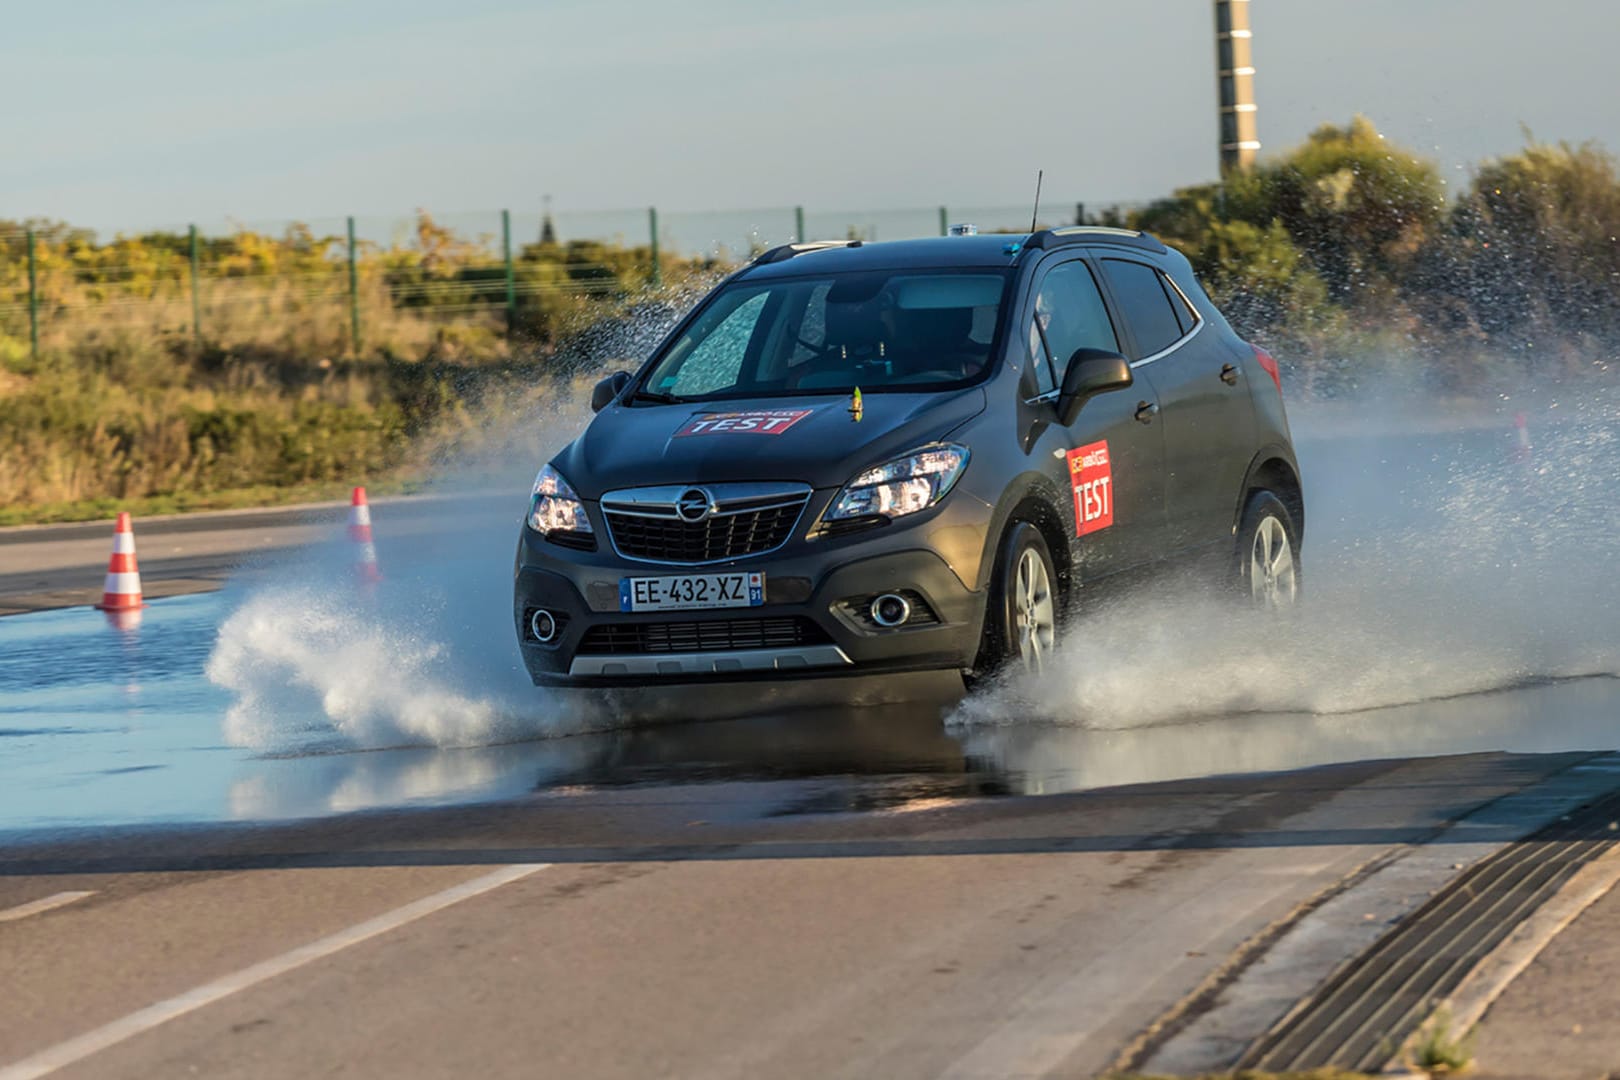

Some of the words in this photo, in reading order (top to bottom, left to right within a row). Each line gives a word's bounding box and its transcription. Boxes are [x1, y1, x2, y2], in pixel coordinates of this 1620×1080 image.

[690, 417, 791, 433] TEST
[1074, 476, 1110, 524] TEST
[634, 576, 745, 604] EE-432-XZ
